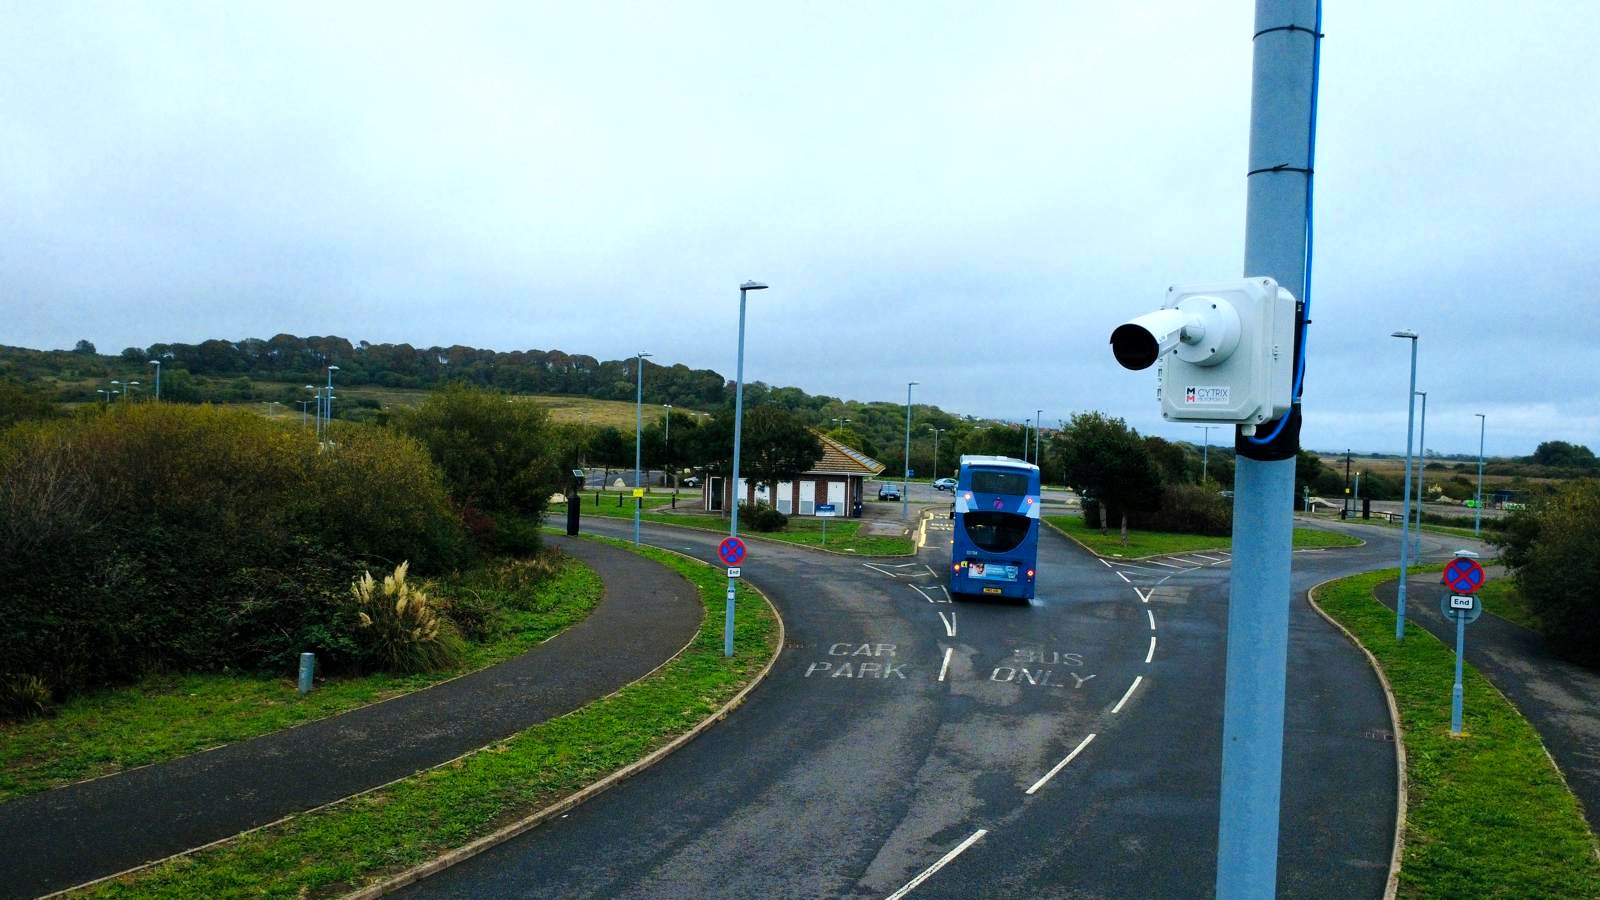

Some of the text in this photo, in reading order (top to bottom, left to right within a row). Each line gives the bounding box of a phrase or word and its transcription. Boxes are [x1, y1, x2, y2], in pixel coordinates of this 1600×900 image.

[1197, 388, 1228, 397] CYTRIX
[828, 643, 897, 657] CAR
[804, 662, 908, 679] PARK
[989, 666, 1097, 689] ONLY
